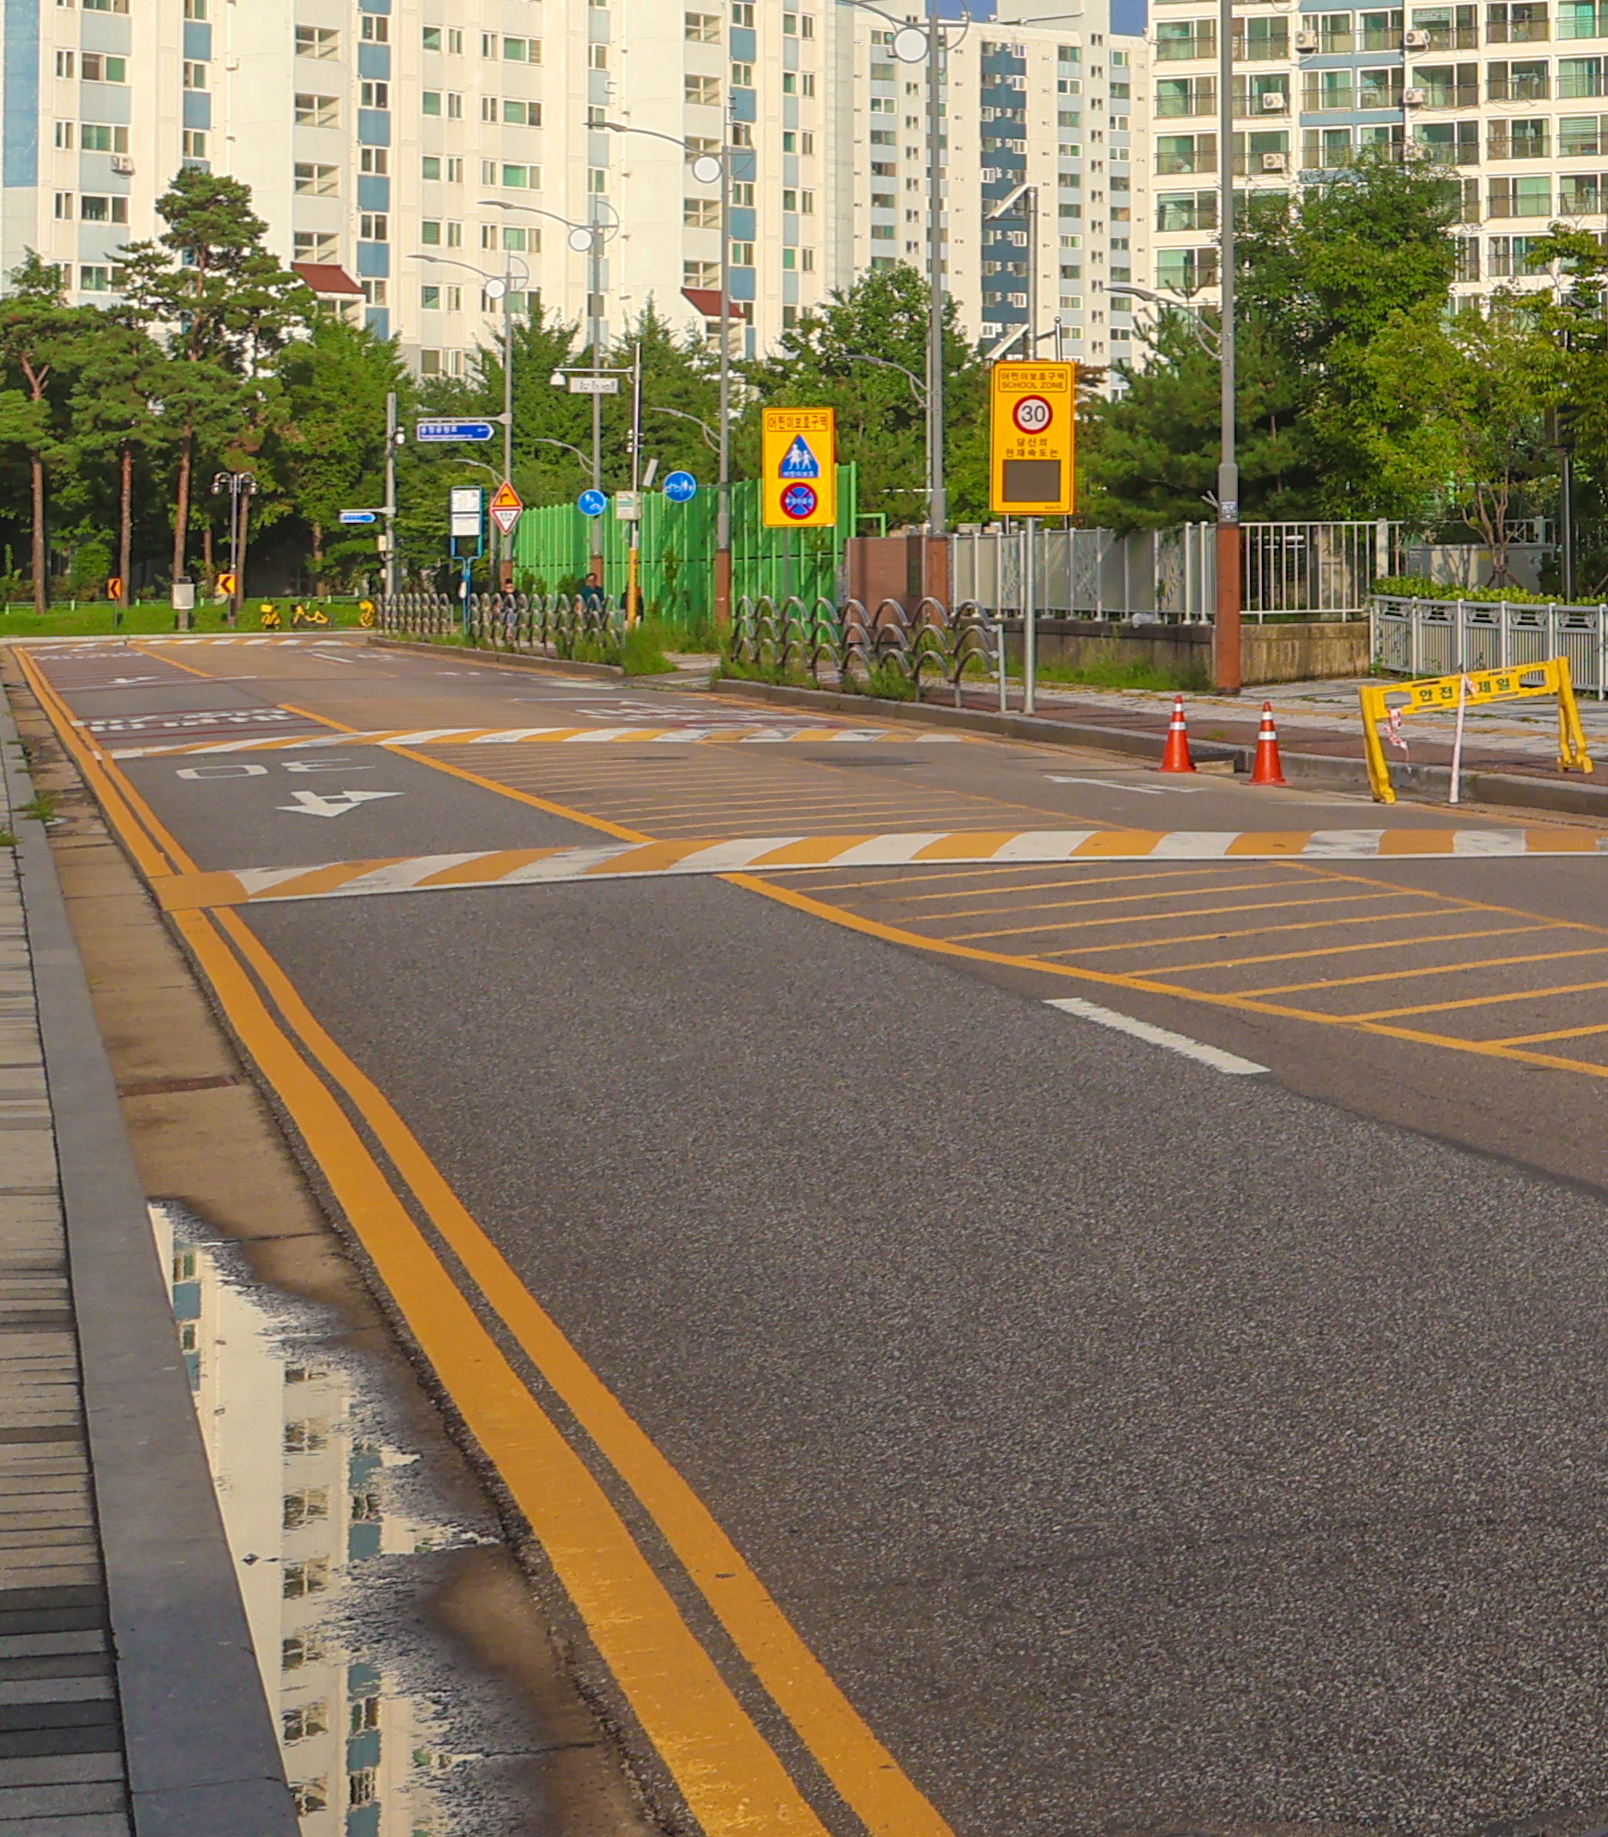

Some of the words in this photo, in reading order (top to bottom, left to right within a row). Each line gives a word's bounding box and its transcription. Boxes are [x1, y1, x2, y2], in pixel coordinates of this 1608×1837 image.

[1001, 372, 1065, 381] 어린이보호구역
[1002, 381, 1038, 389] SCHOOL
[1040, 381, 1064, 389] ZONE
[1021, 405, 1046, 423] 30
[769, 415, 828, 430] 어린이보호구역
[1016, 437, 1048, 447] 당신의
[1419, 686, 1453, 703] 안전
[1477, 677, 1511, 694] 제일
